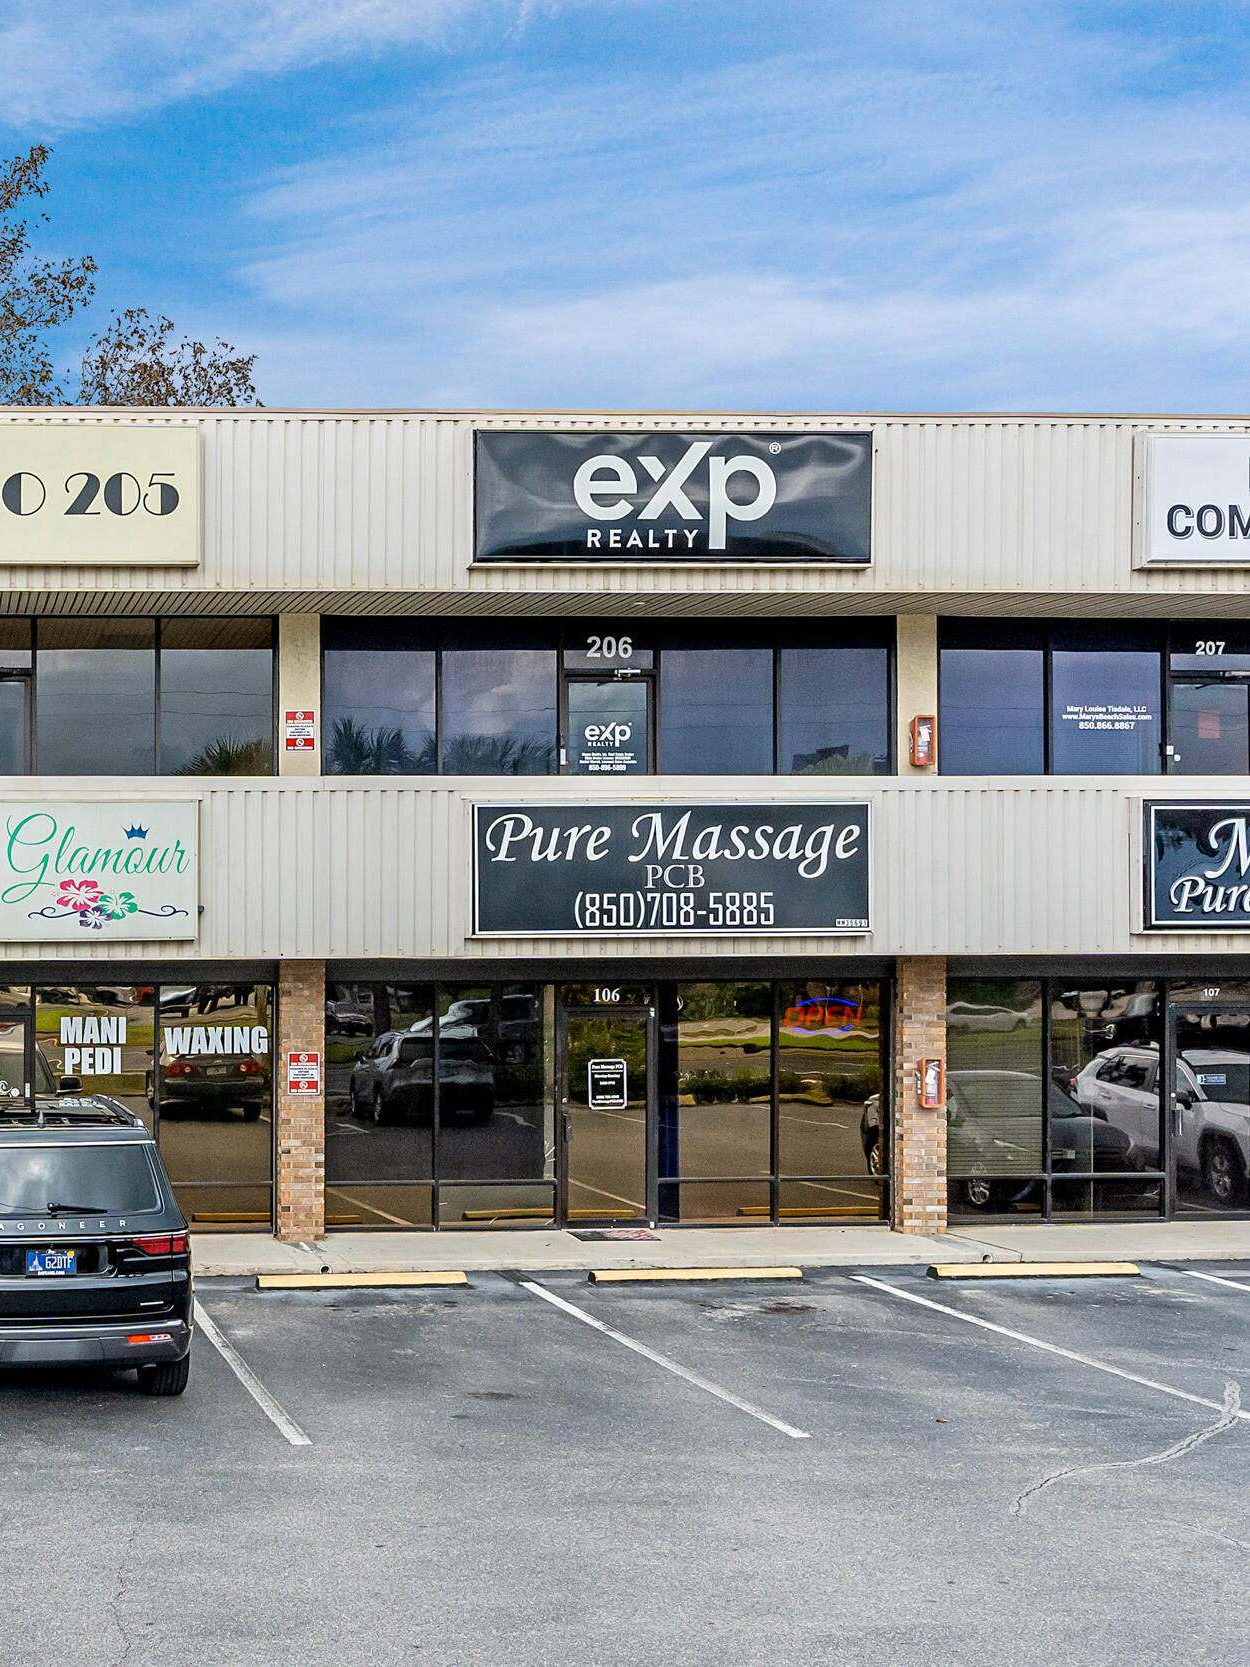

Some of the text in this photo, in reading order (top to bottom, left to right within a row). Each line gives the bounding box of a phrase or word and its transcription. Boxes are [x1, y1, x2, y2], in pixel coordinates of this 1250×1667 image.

[64, 472, 180, 516] 205
[587, 529, 699, 548] REALTY
[586, 636, 633, 658] 206
[1195, 641, 1225, 656] 207
[1066, 705, 1083, 713] Mary
[1084, 705, 1106, 713] Louise
[1134, 705, 1147, 713] LLC
[1078, 722, 1135, 730] 850.866.8867
[485, 810, 861, 879] Pure Massage
[1, 813, 190, 904] Glamour
[644, 864, 706, 889] PCB
[573, 891, 775, 929] (850)708-5885
[593, 987, 620, 1002] 106
[1203, 988, 1220, 997] 107
[784, 1005, 862, 1027] OPEN
[60, 1016, 127, 1045] MANI
[163, 1025, 268, 1055] WAXING
[64, 1047, 122, 1075] PEDI
[45, 1256, 73, 1269] 62DTF
